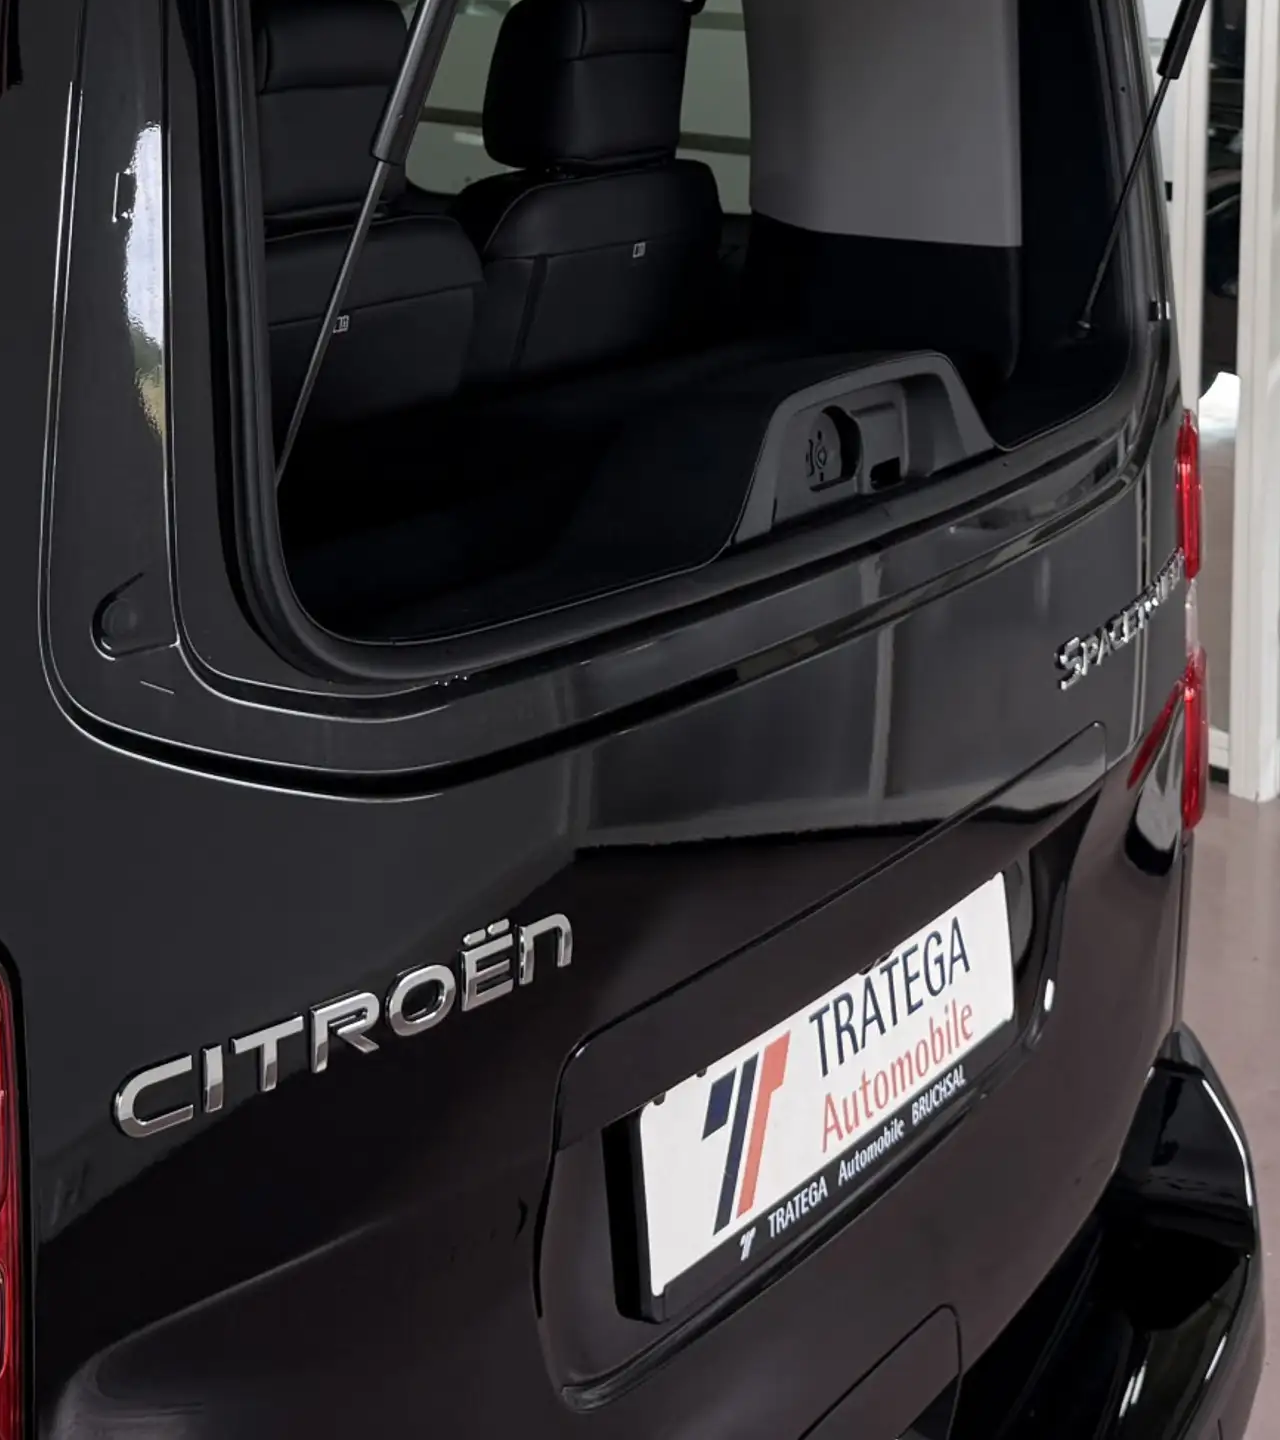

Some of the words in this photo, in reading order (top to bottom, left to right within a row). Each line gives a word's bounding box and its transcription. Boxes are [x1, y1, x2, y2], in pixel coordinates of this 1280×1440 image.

[808, 915, 972, 1079] TRATEGA
[821, 997, 975, 1155] Automobile
[767, 1175, 829, 1239] TRATEGA
[837, 1117, 905, 1187] Automobile
[911, 1063, 967, 1127] BRUCHSAL
